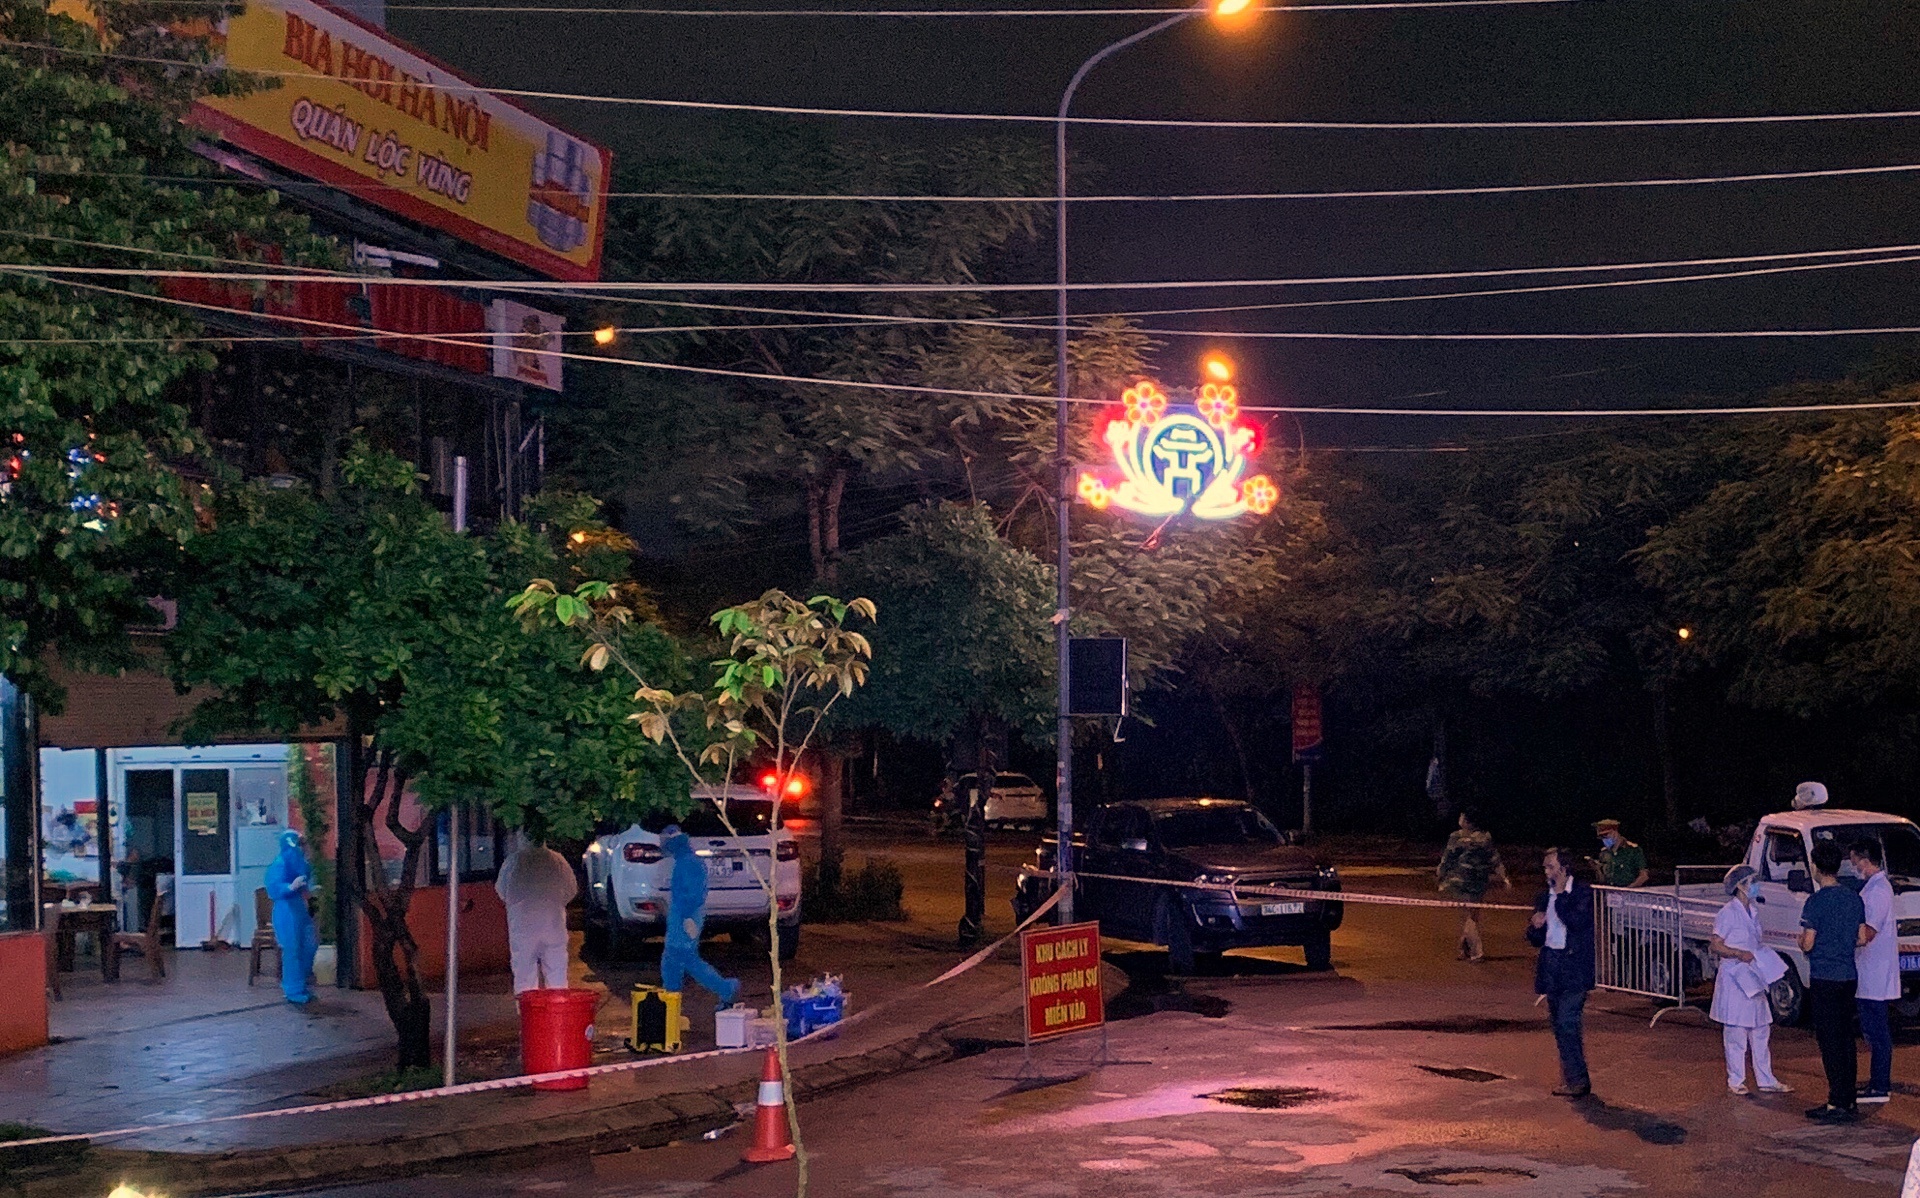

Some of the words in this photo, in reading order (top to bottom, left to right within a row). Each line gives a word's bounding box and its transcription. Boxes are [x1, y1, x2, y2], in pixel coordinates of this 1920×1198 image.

[283, 11, 332, 76] BIA
[396, 71, 438, 128] HÀ
[290, 96, 363, 157] QUÁN
[363, 128, 412, 178] LỘC
[1035, 942, 1054, 964] KHU
[1055, 938, 1079, 960] CÁCH
[1030, 973, 1060, 997] KHÔNG
